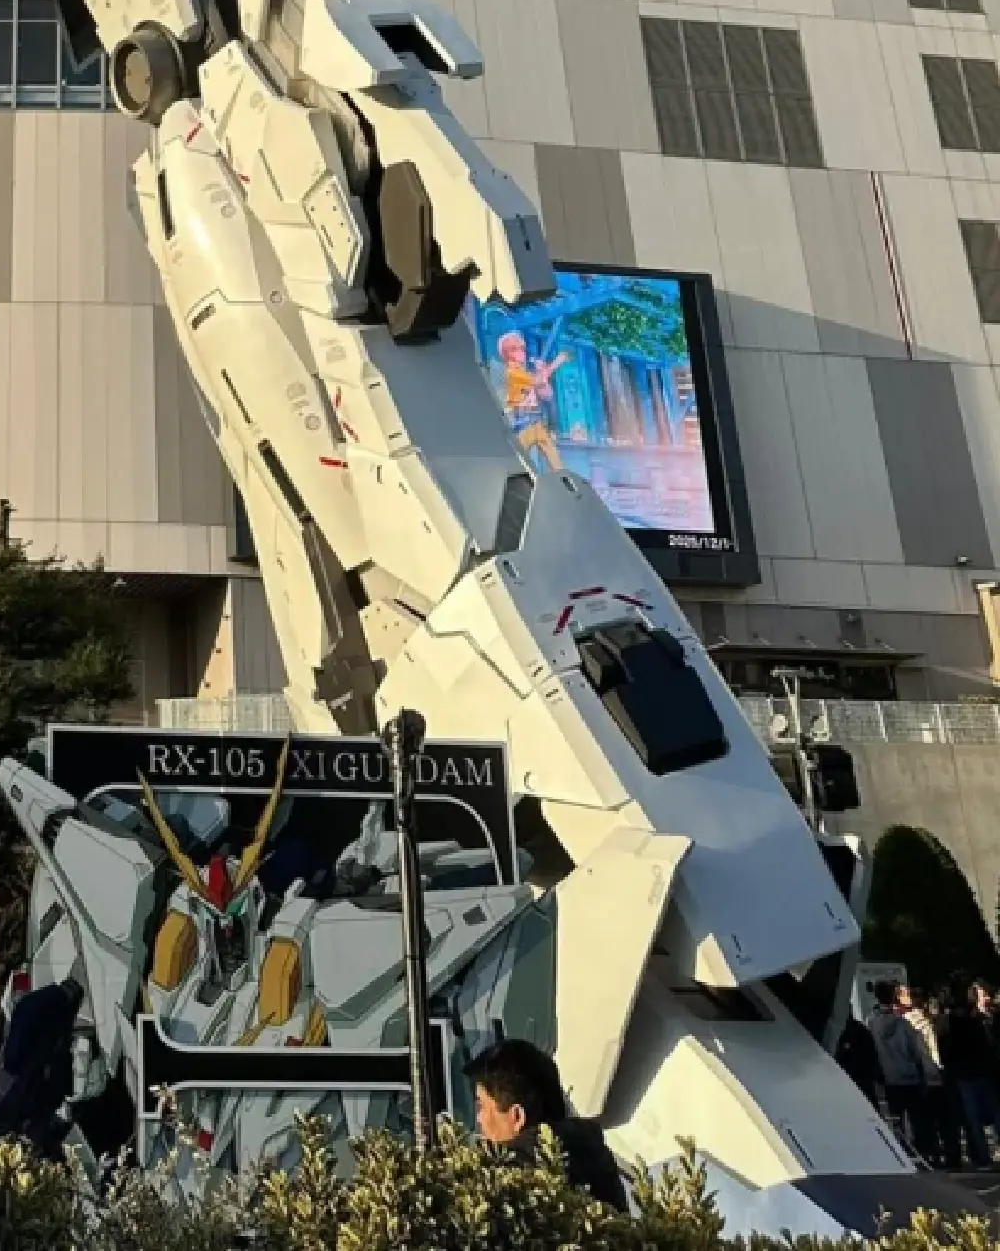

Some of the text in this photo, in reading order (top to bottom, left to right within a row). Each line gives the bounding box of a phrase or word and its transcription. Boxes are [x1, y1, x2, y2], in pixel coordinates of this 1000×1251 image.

[148, 744, 493, 786] RX-105 XI GUDAM
